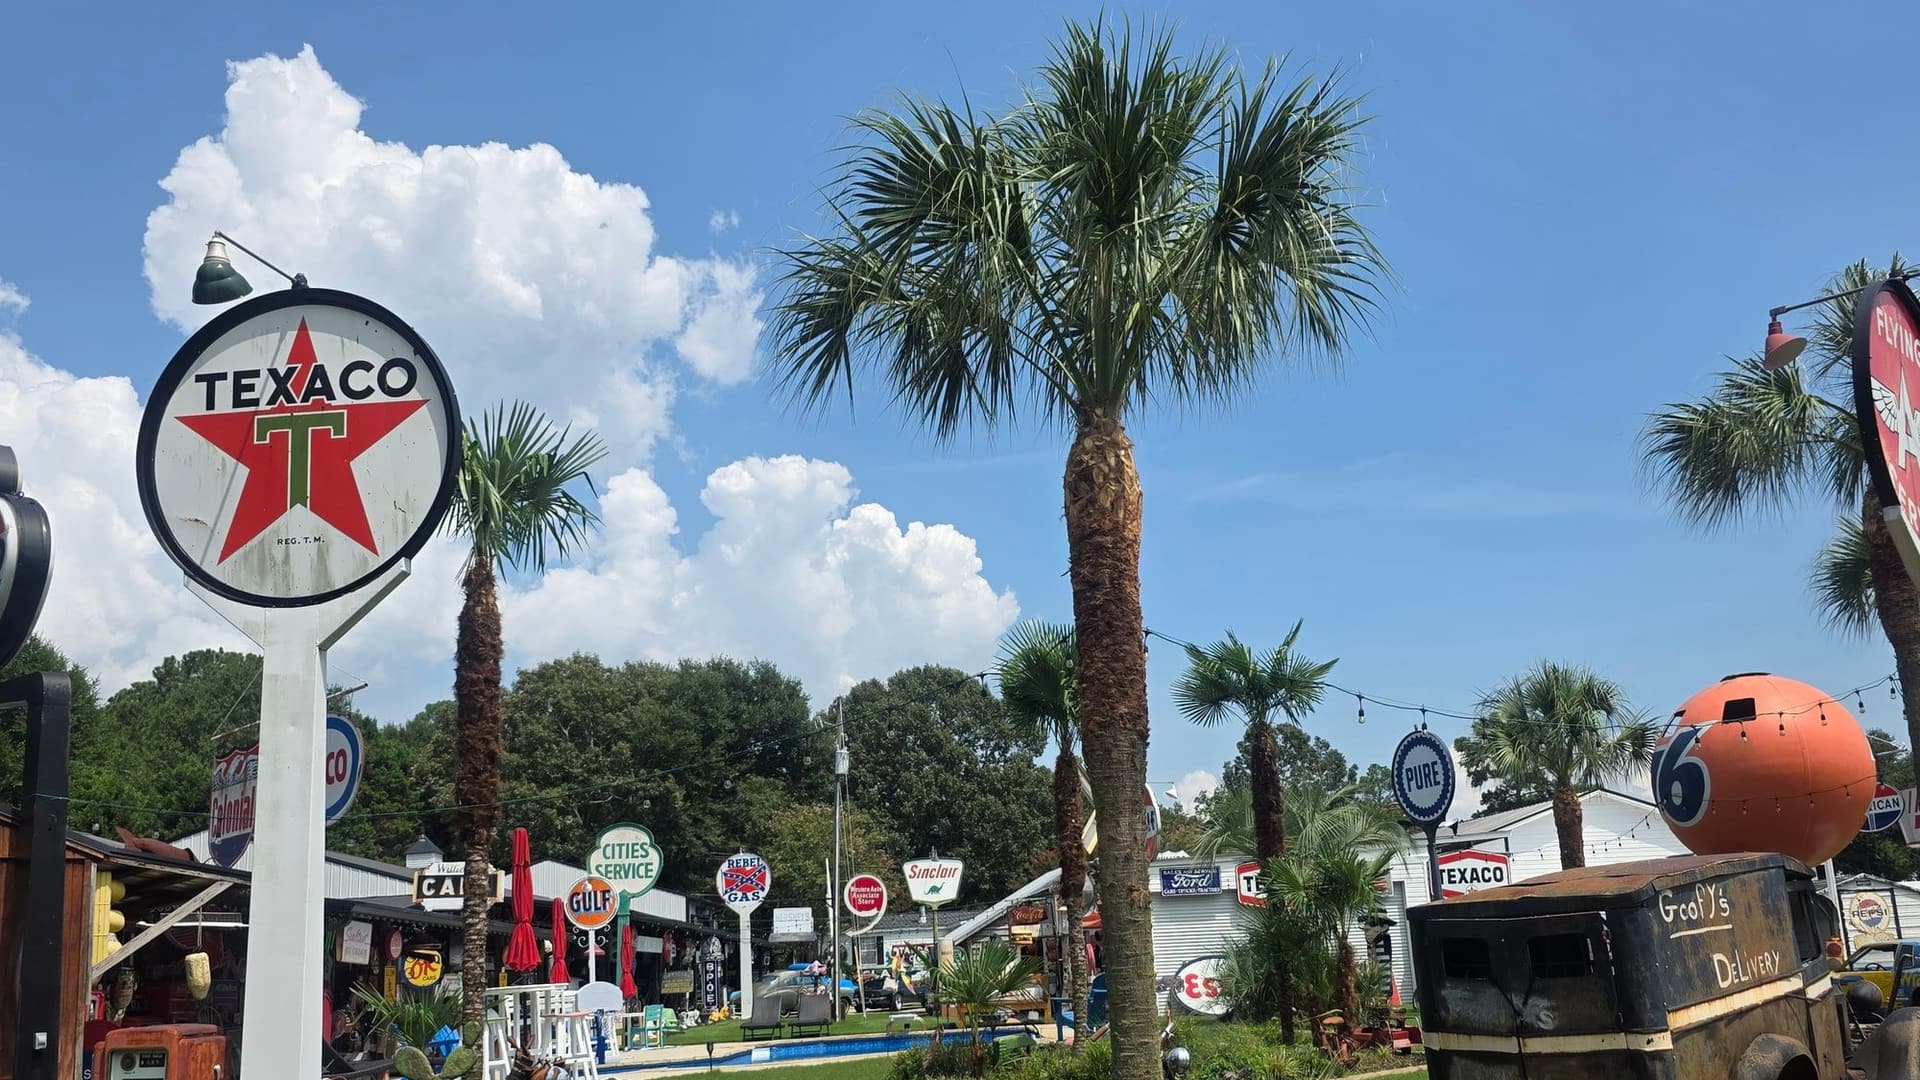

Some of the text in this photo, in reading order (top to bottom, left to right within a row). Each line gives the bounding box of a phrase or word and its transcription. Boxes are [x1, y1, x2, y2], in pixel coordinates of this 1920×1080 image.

[194, 357, 418, 411] TEXACO
[254, 410, 347, 511] T
[277, 537, 301, 545] REG.
[1405, 760, 1441, 793] PURE
[211, 785, 256, 838] Colonial
[1870, 797, 1900, 811] ICAN
[602, 842, 650, 859] CITIES
[594, 862, 654, 880] SERVICE
[727, 857, 764, 868] REBEL
[908, 864, 959, 879] Sinclair
[1171, 873, 1212, 888] Ford
[1440, 866, 1504, 885] TEXACO
[422, 876, 464, 897] CA
[569, 889, 612, 913] GULF
[728, 891, 761, 902] GAS
